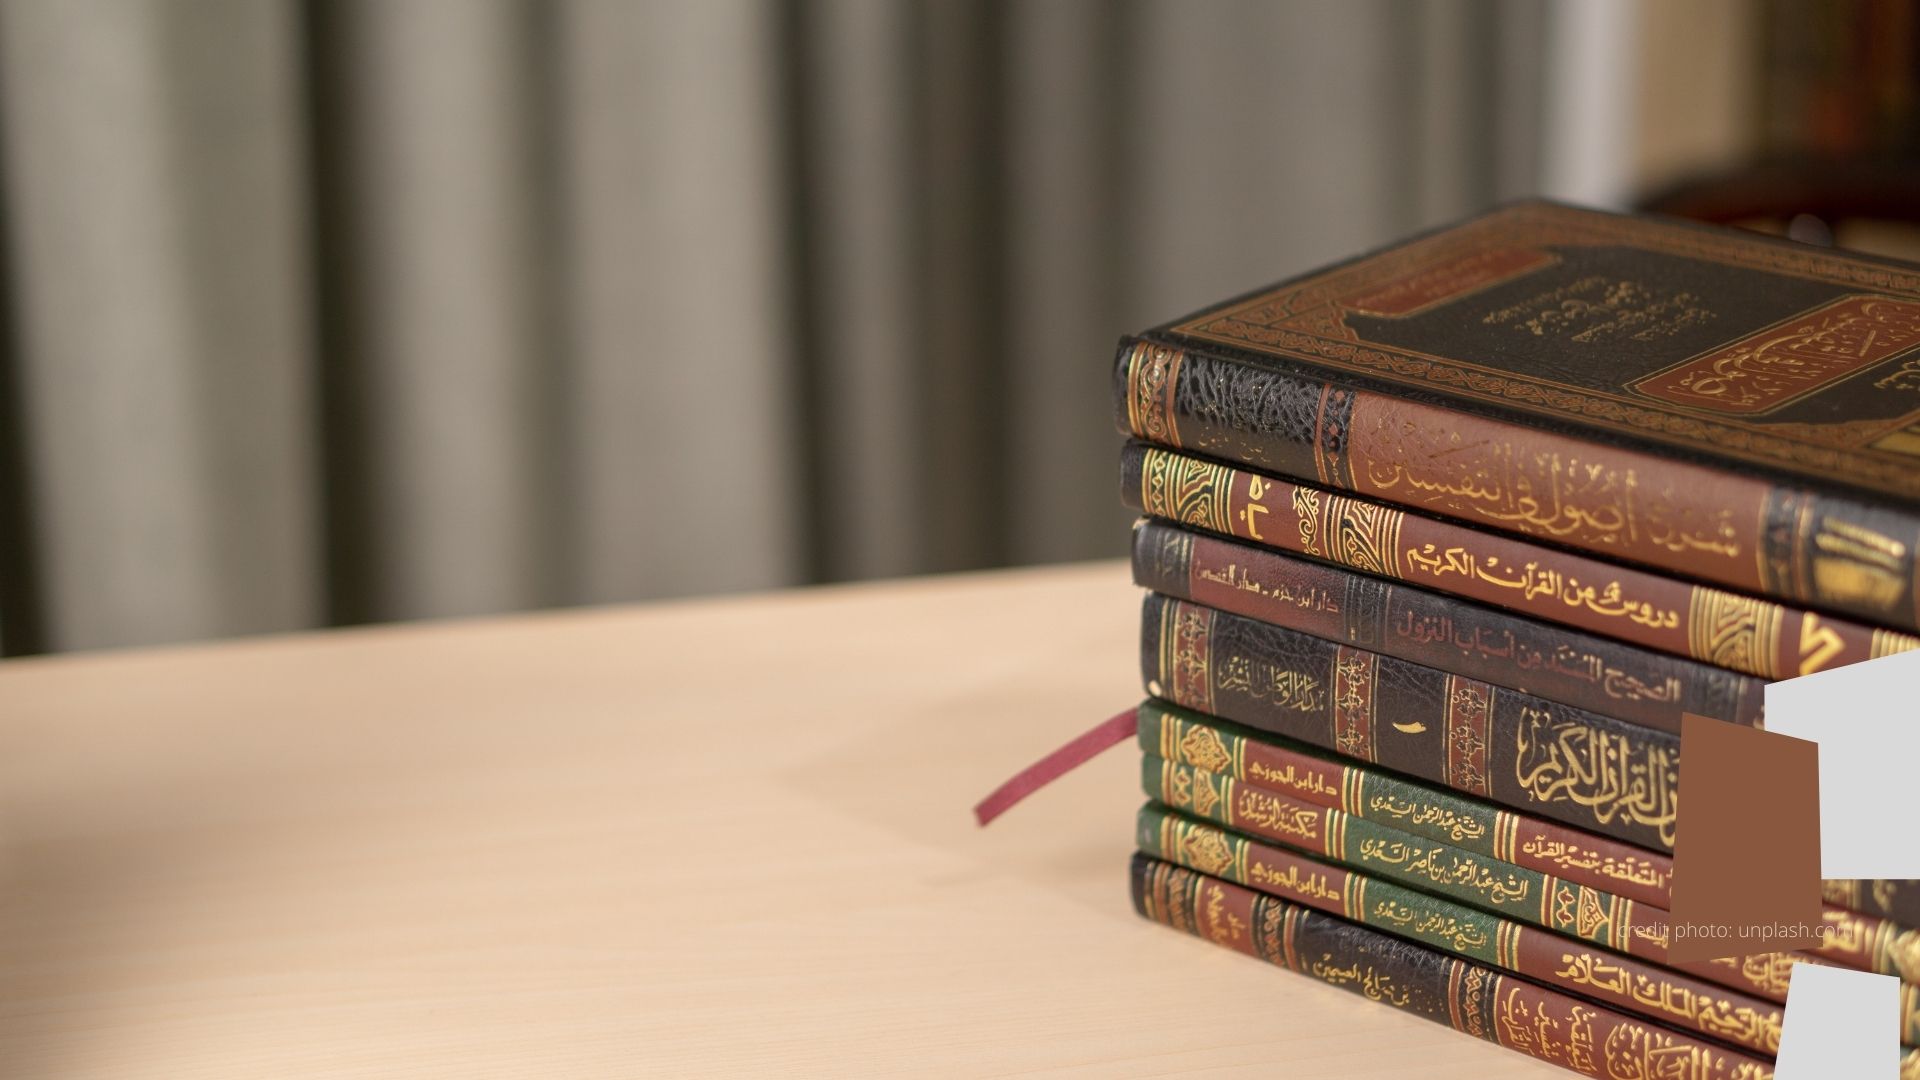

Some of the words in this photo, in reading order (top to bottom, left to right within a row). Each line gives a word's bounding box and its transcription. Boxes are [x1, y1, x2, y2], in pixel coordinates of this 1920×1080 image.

[1406, 543, 1476, 580] الكريم
[1476, 556, 1563, 601] القرآن
[1563, 577, 1595, 606] من
[1586, 580, 1680, 629] دروس
[1396, 609, 1453, 644] النزول
[1516, 645, 1541, 670] من
[1602, 667, 1683, 702] الصحيح
[1248, 760, 1295, 784] الجوزي
[1293, 770, 1313, 790] ابن
[1311, 773, 1338, 797] دار
[1370, 793, 1416, 819] السعدي
[1450, 814, 1486, 842] الشيخ
[1359, 838, 1409, 865] السعدي
[1522, 834, 1566, 862] القرآن
[1559, 846, 1604, 875] بتفسير
[1250, 861, 1299, 888] الجوزي
[1296, 871, 1317, 896] ابن
[1602, 857, 1666, 890] المتعلقة
[1314, 874, 1341, 902] دار
[1491, 873, 1530, 905] الشيخ
[1373, 899, 1417, 926] السعدي
[1452, 922, 1487, 951] الشيخ
[1554, 952, 1632, 998] العلام
[1632, 973, 1699, 1021] الملك
